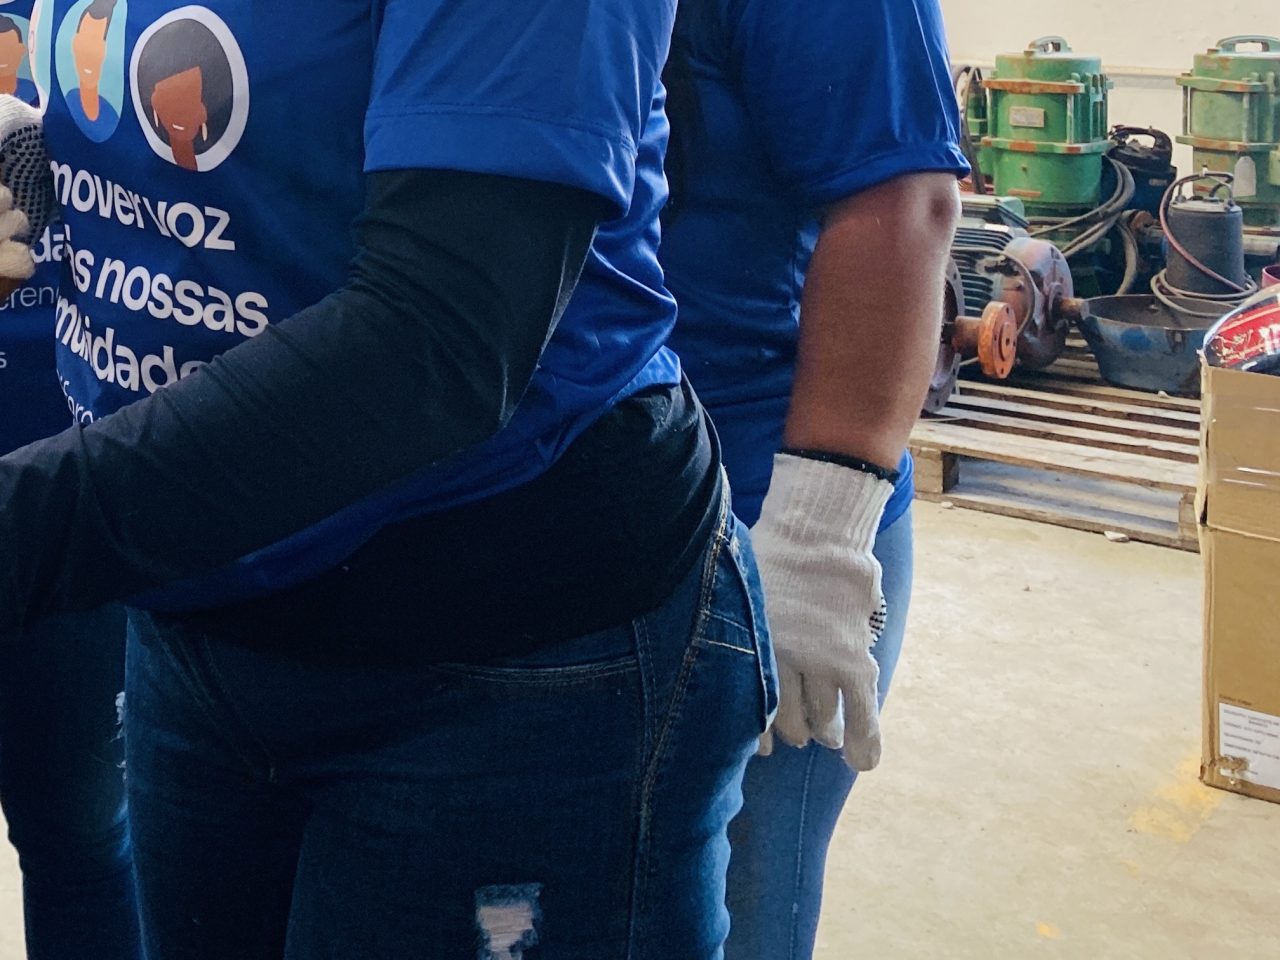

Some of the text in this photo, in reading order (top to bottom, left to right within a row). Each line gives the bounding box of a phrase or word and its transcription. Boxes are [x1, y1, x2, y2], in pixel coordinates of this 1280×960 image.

[50, 159, 236, 251] mover voz
[94, 257, 269, 338] nossas
